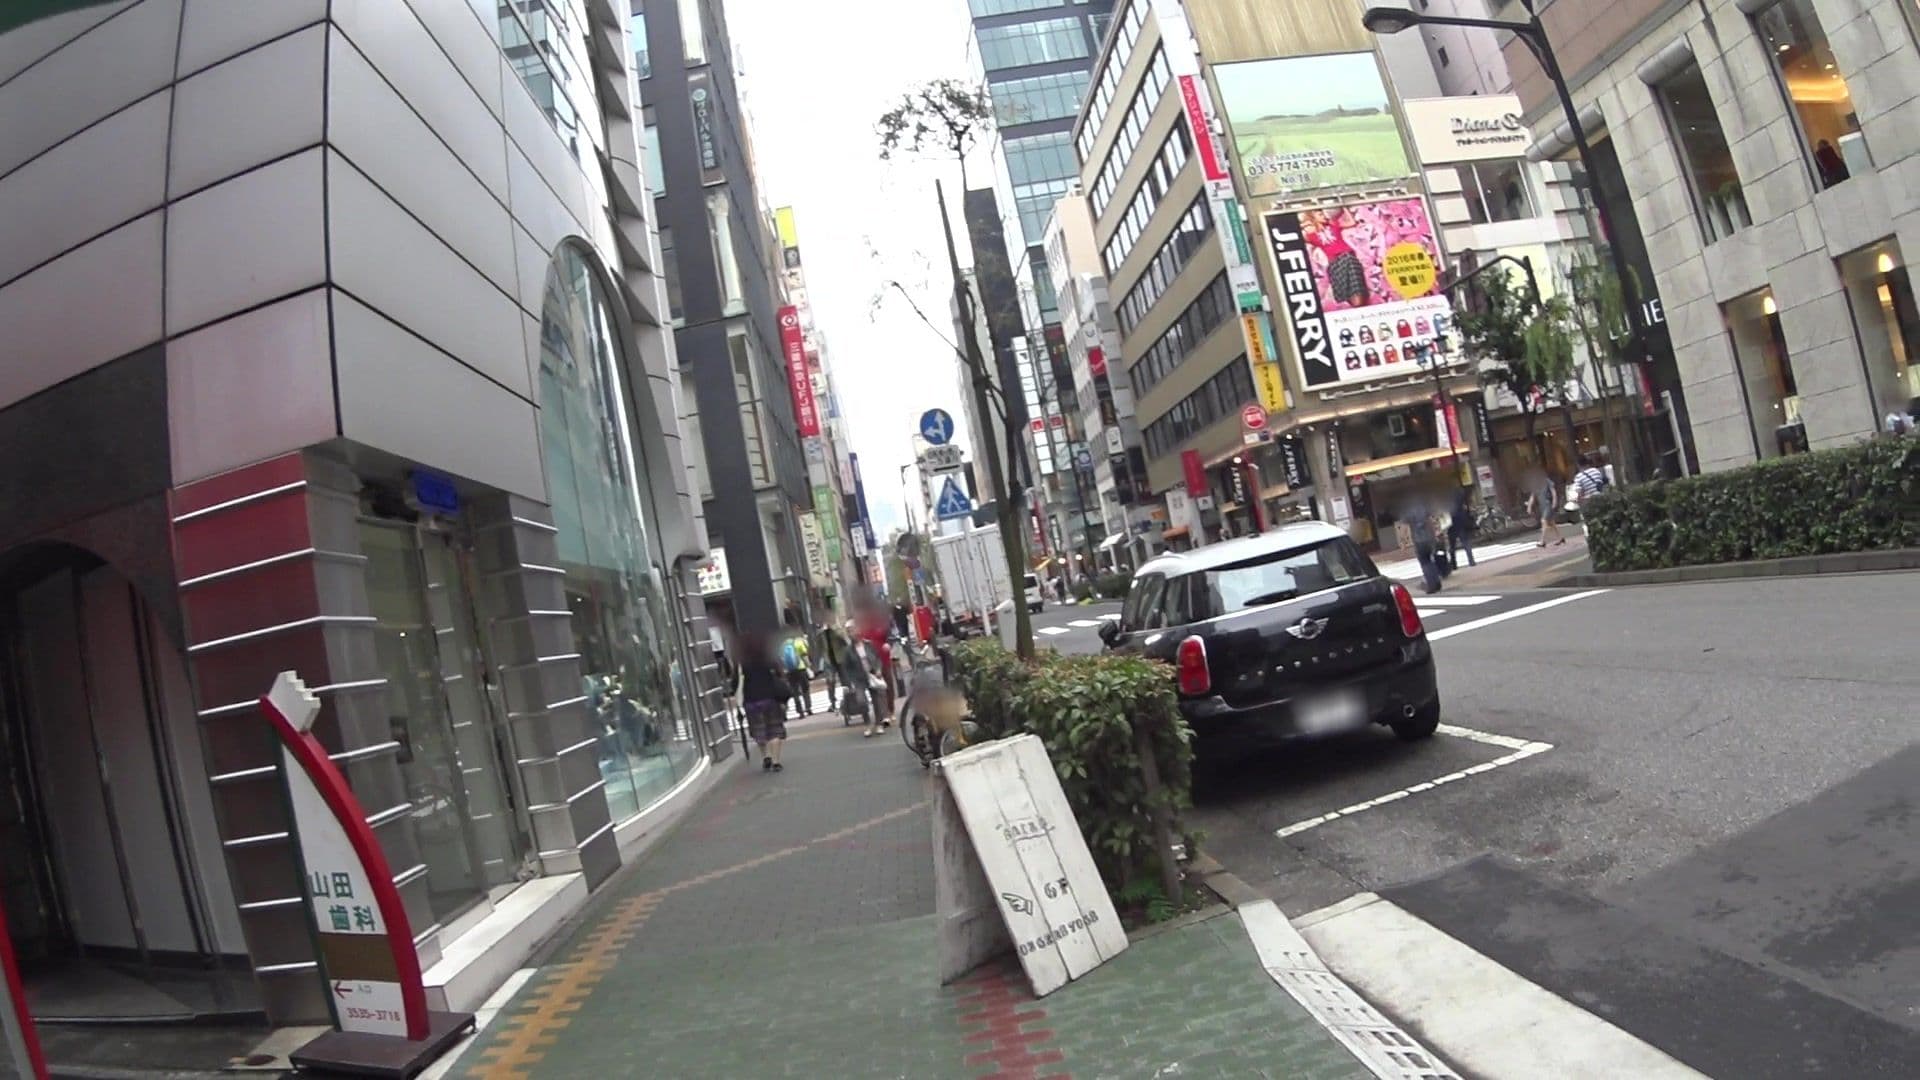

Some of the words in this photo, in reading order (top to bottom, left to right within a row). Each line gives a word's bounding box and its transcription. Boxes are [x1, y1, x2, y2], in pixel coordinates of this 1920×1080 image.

[1272, 227, 1332, 368] J.FERRY
[310, 871, 354, 899] 山田
[328, 903, 376, 932] 歯科
